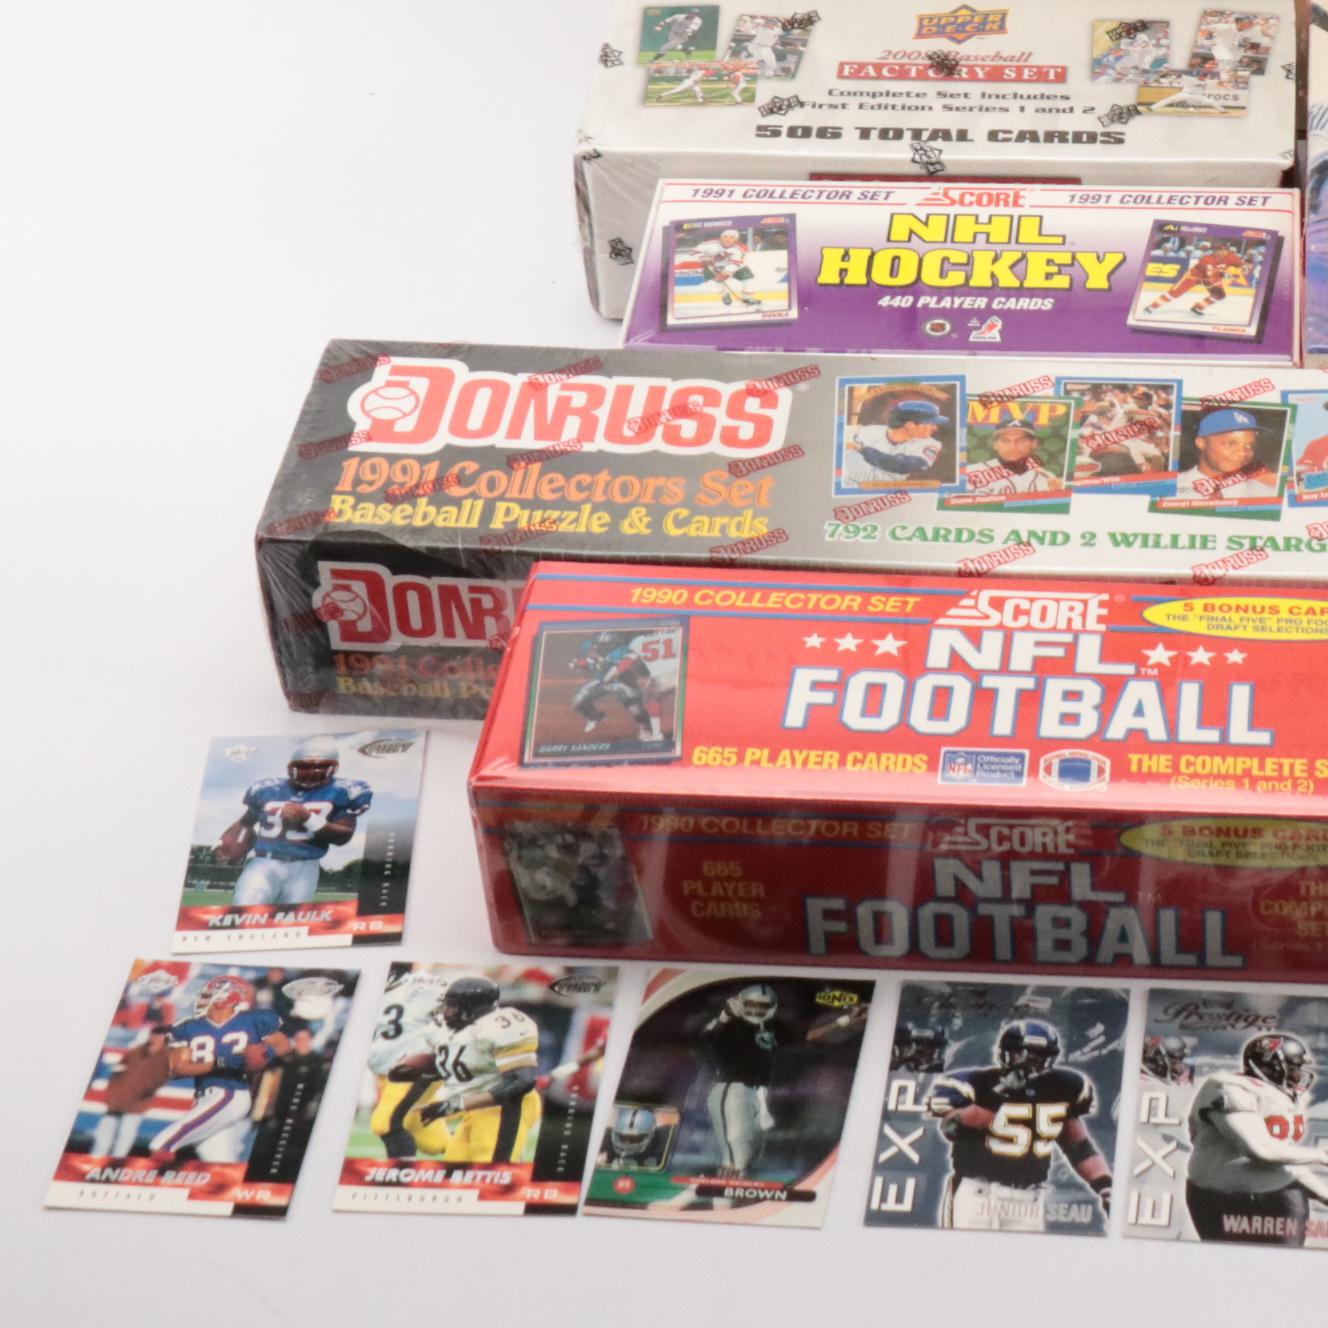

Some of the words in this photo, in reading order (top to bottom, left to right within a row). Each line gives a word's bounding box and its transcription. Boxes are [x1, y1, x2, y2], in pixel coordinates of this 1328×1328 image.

[922, 13, 1001, 25] UPPER
[840, 64, 996, 80] FACTORY
[1002, 67, 1062, 80] SET
[828, 88, 928, 99] Complete
[936, 90, 973, 99] Set
[980, 91, 1071, 101] Includes
[799, 101, 851, 110] First
[858, 101, 934, 111] Edition
[941, 103, 1010, 113] Series
[1033, 105, 1074, 114] and
[754, 124, 844, 142] 506
[855, 125, 976, 144] TOTAL
[983, 126, 1127, 145] CARDS
[689, 187, 738, 200] 1991
[742, 187, 855, 202] COLLECTOR
[858, 189, 897, 202] SET
[916, 186, 1028, 208] SCORE
[887, 212, 1067, 248] NHL
[817, 246, 1127, 293] HOCKEY
[877, 294, 915, 309] 440
[919, 295, 988, 312] PLAYER
[991, 296, 1055, 313] CARDS
[359, 364, 780, 450] DONRUSS
[965, 401, 1068, 428] MVP
[445, 461, 686, 505] Collectors
[694, 469, 776, 507] Set
[329, 495, 484, 529] Baseball
[621, 507, 652, 534] &
[663, 507, 768, 539] Cards
[823, 520, 881, 542] 792
[887, 525, 996, 545] CARDS
[1002, 528, 1072, 547] AND
[1109, 531, 1218, 551] WILLIE
[629, 587, 689, 605] 1990
[693, 589, 865, 610] COLLECTOR
[868, 594, 921, 613] SET
[930, 586, 1112, 634] SCORE
[1183, 602, 1195, 612] 5
[1202, 603, 1281, 615] BONUS
[1207, 623, 1250, 632] DRAFT
[1276, 617, 1304, 625] PRO
[926, 628, 1140, 676] NFL
[784, 668, 1276, 748] FOOTBALL
[691, 746, 739, 767] 665
[744, 747, 842, 771] PLAYER
[846, 750, 929, 773] CARDS
[1128, 753, 1181, 773] THE
[1185, 754, 1309, 777] COMPLETE
[932, 856, 1128, 910] NFL
[208, 914, 270, 927] KEVIN
[804, 894, 1248, 970] FOOTBALL
[366, 1168, 445, 1185] JEROME
[724, 1186, 788, 1201] BROWN
[1046, 1204, 1093, 1223] SEAU
[1222, 1213, 1299, 1234] WARREN
